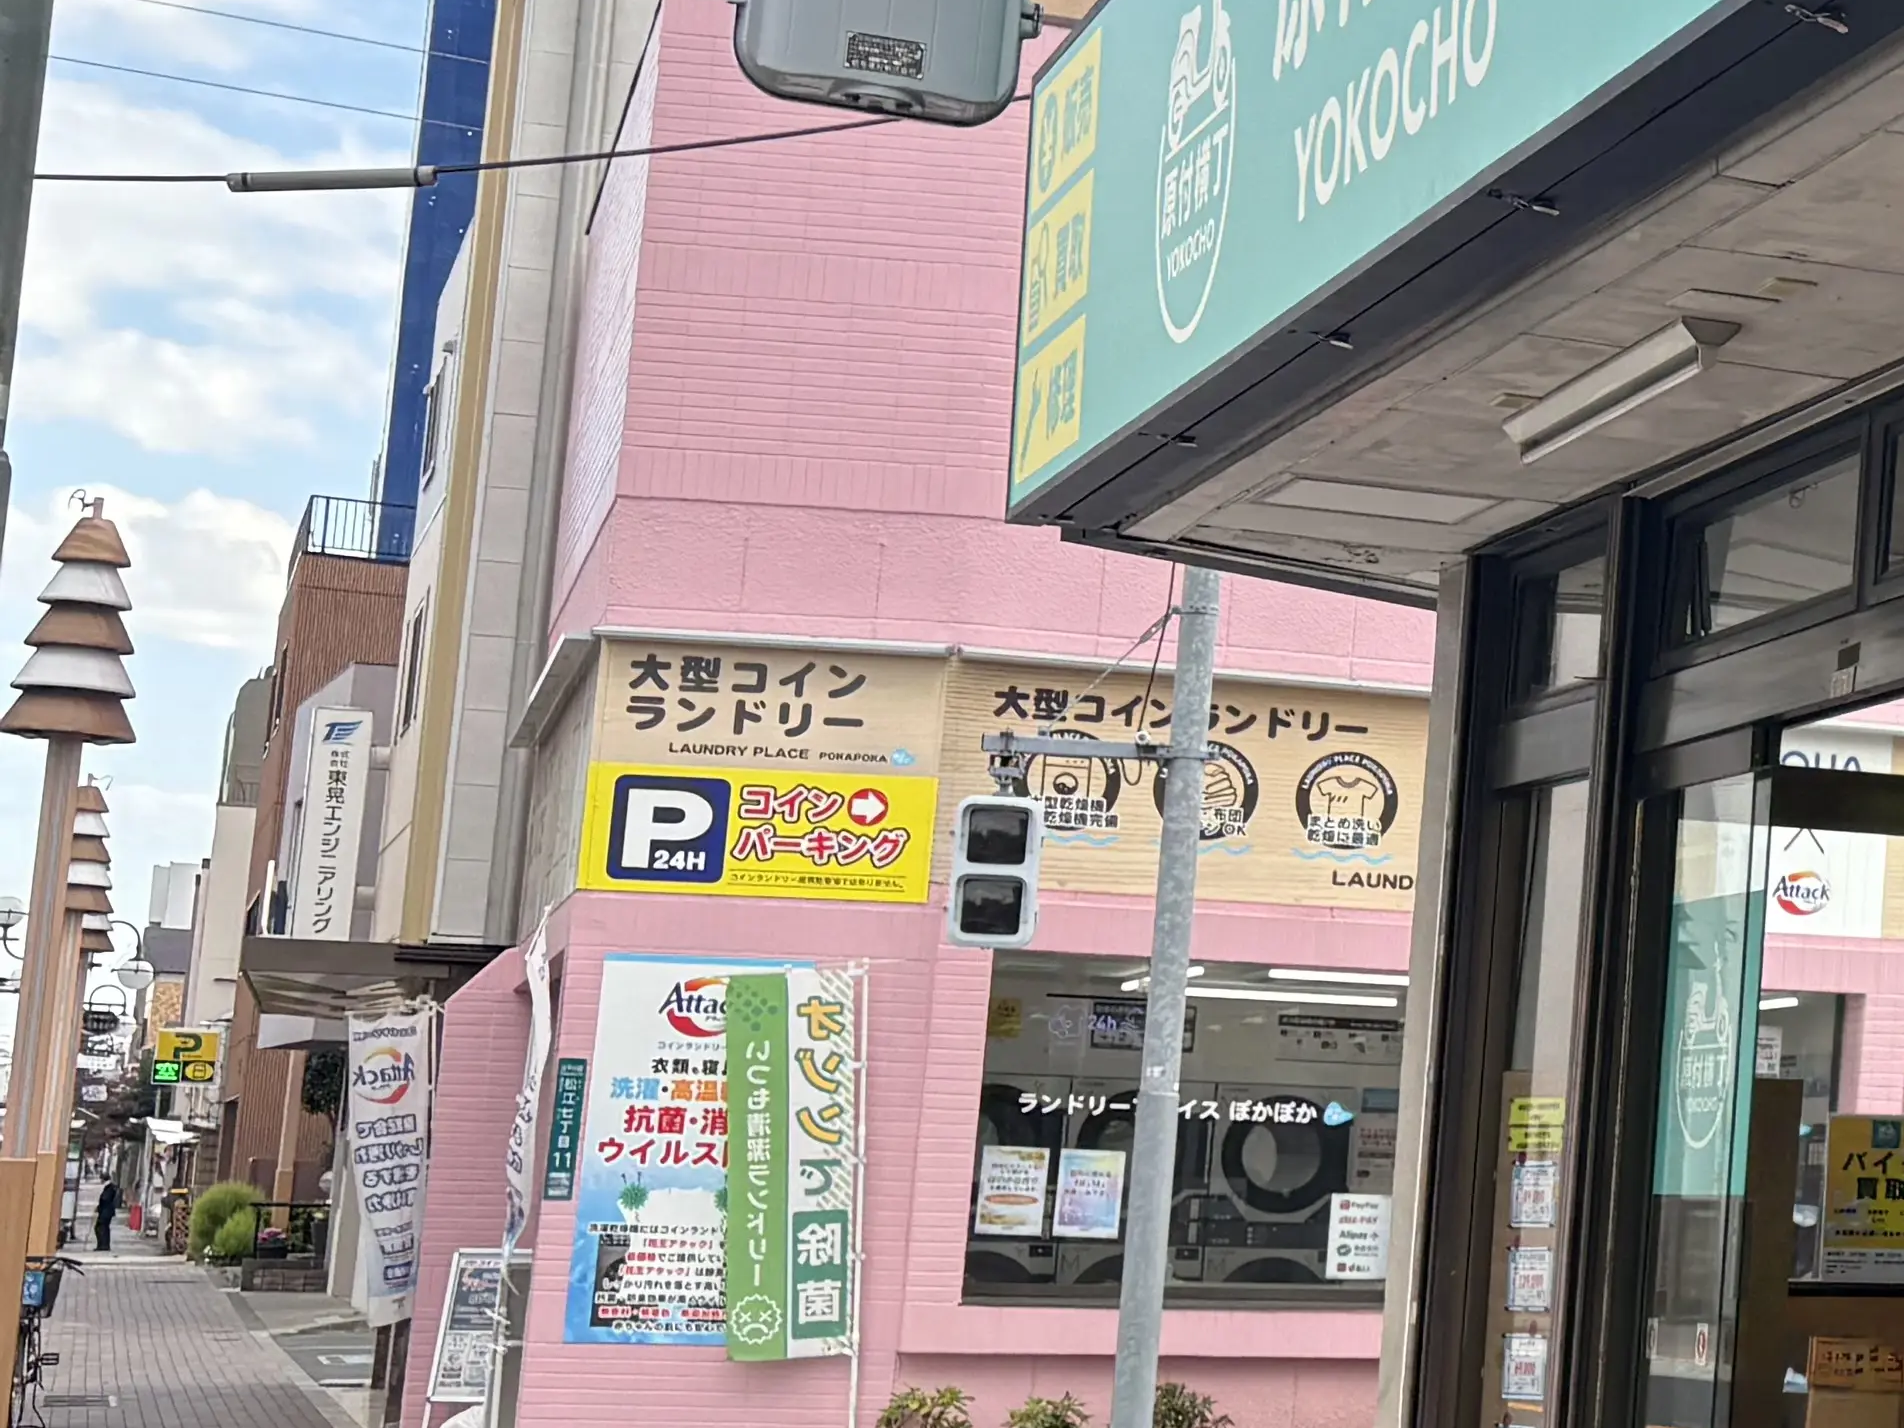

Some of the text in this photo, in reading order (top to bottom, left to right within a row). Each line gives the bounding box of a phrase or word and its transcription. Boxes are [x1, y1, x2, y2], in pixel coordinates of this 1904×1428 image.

[1061, 64, 1093, 162] 販売
[1161, 123, 1229, 240] 原付横丁
[1053, 211, 1085, 304] 買取
[1166, 218, 1215, 282] YOKOCHO
[1046, 351, 1079, 440] 修理
[628, 652, 867, 699] 大型コイン
[626, 694, 864, 737] ランドリー
[668, 742, 749, 759] LAUNDRY
[753, 745, 809, 760] PLACE
[738, 783, 844, 824] コイン
[620, 786, 714, 872] P 24H
[731, 825, 910, 869] パーキング
[1332, 870, 1414, 890] LAUND
[1772, 874, 1831, 903] Attack
[1229, 1097, 1319, 1125] ぽかぽか
[552, 1151, 572, 1169] 11
[597, 1139, 728, 1167] ウイルス
